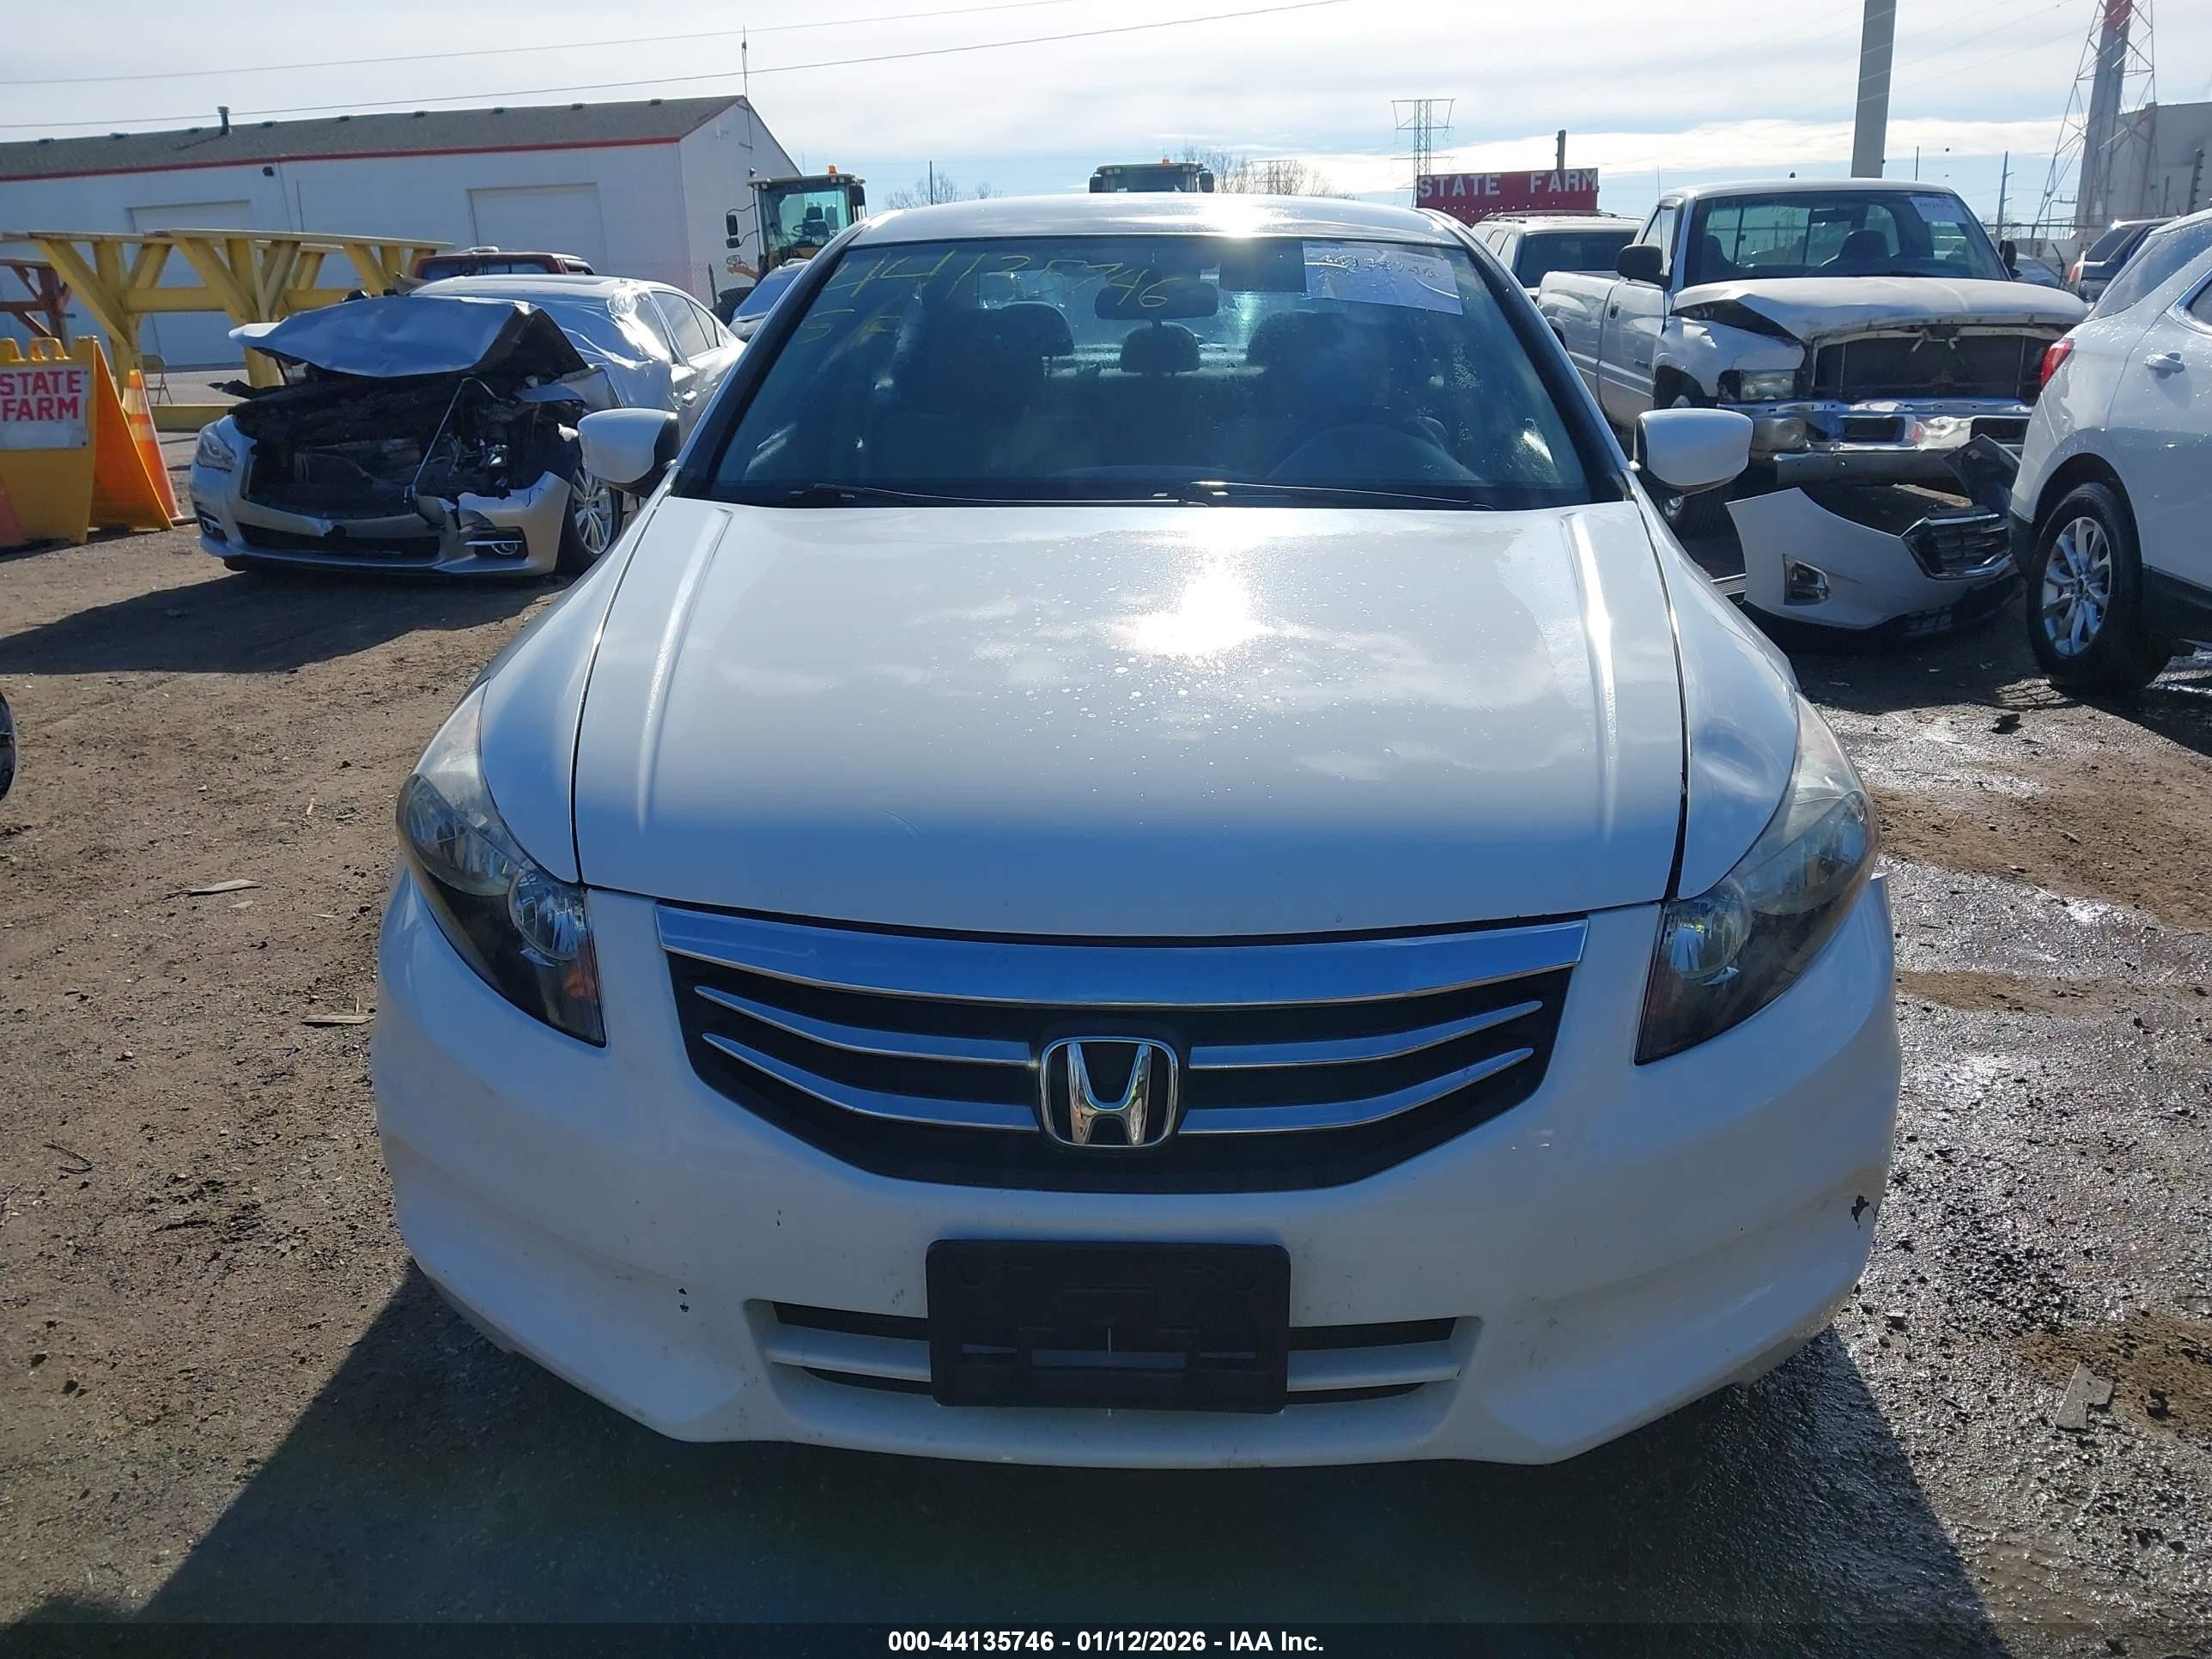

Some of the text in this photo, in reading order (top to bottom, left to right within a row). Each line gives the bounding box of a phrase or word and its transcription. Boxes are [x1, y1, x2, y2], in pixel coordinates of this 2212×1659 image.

[1418, 170, 1597, 198] STATE FARM
[0, 370, 82, 396] STATE
[3, 396, 78, 422] FARM
